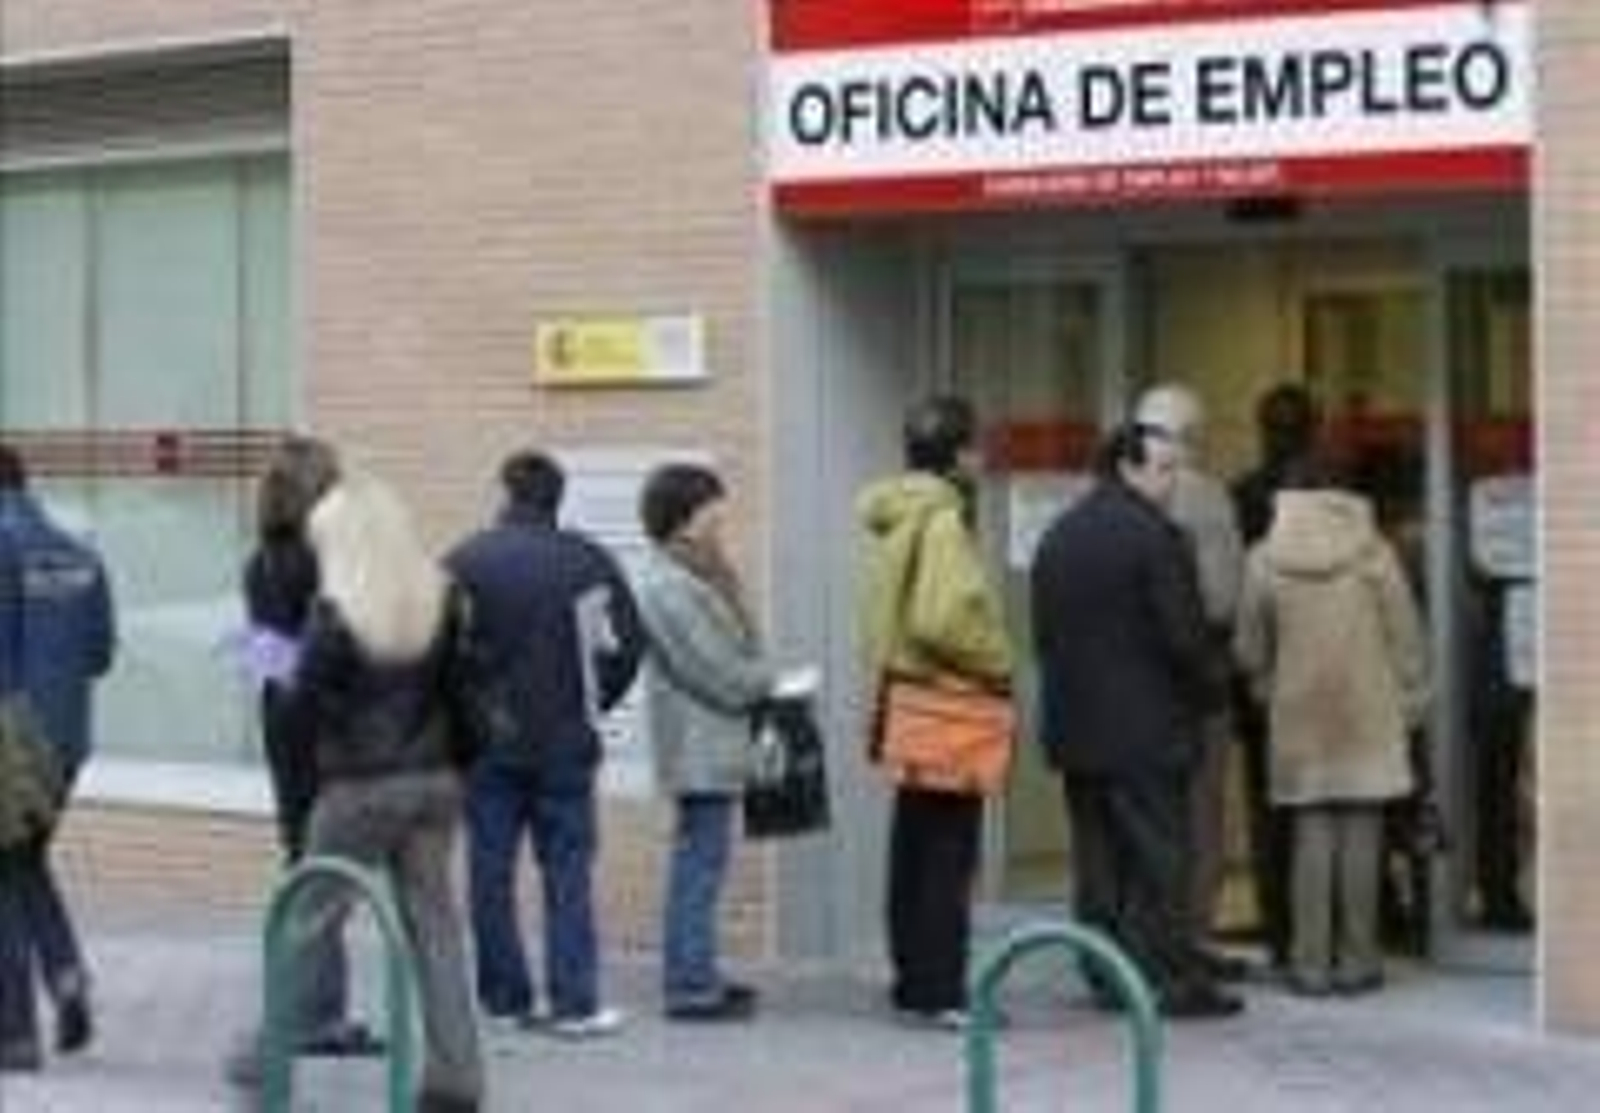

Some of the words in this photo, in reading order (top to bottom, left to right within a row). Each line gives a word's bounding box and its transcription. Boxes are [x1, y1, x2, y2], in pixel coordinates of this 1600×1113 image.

[790, 69, 1054, 145] OFICINA
[1080, 62, 1172, 130] DE
[1195, 42, 1509, 124] EMPLEO
